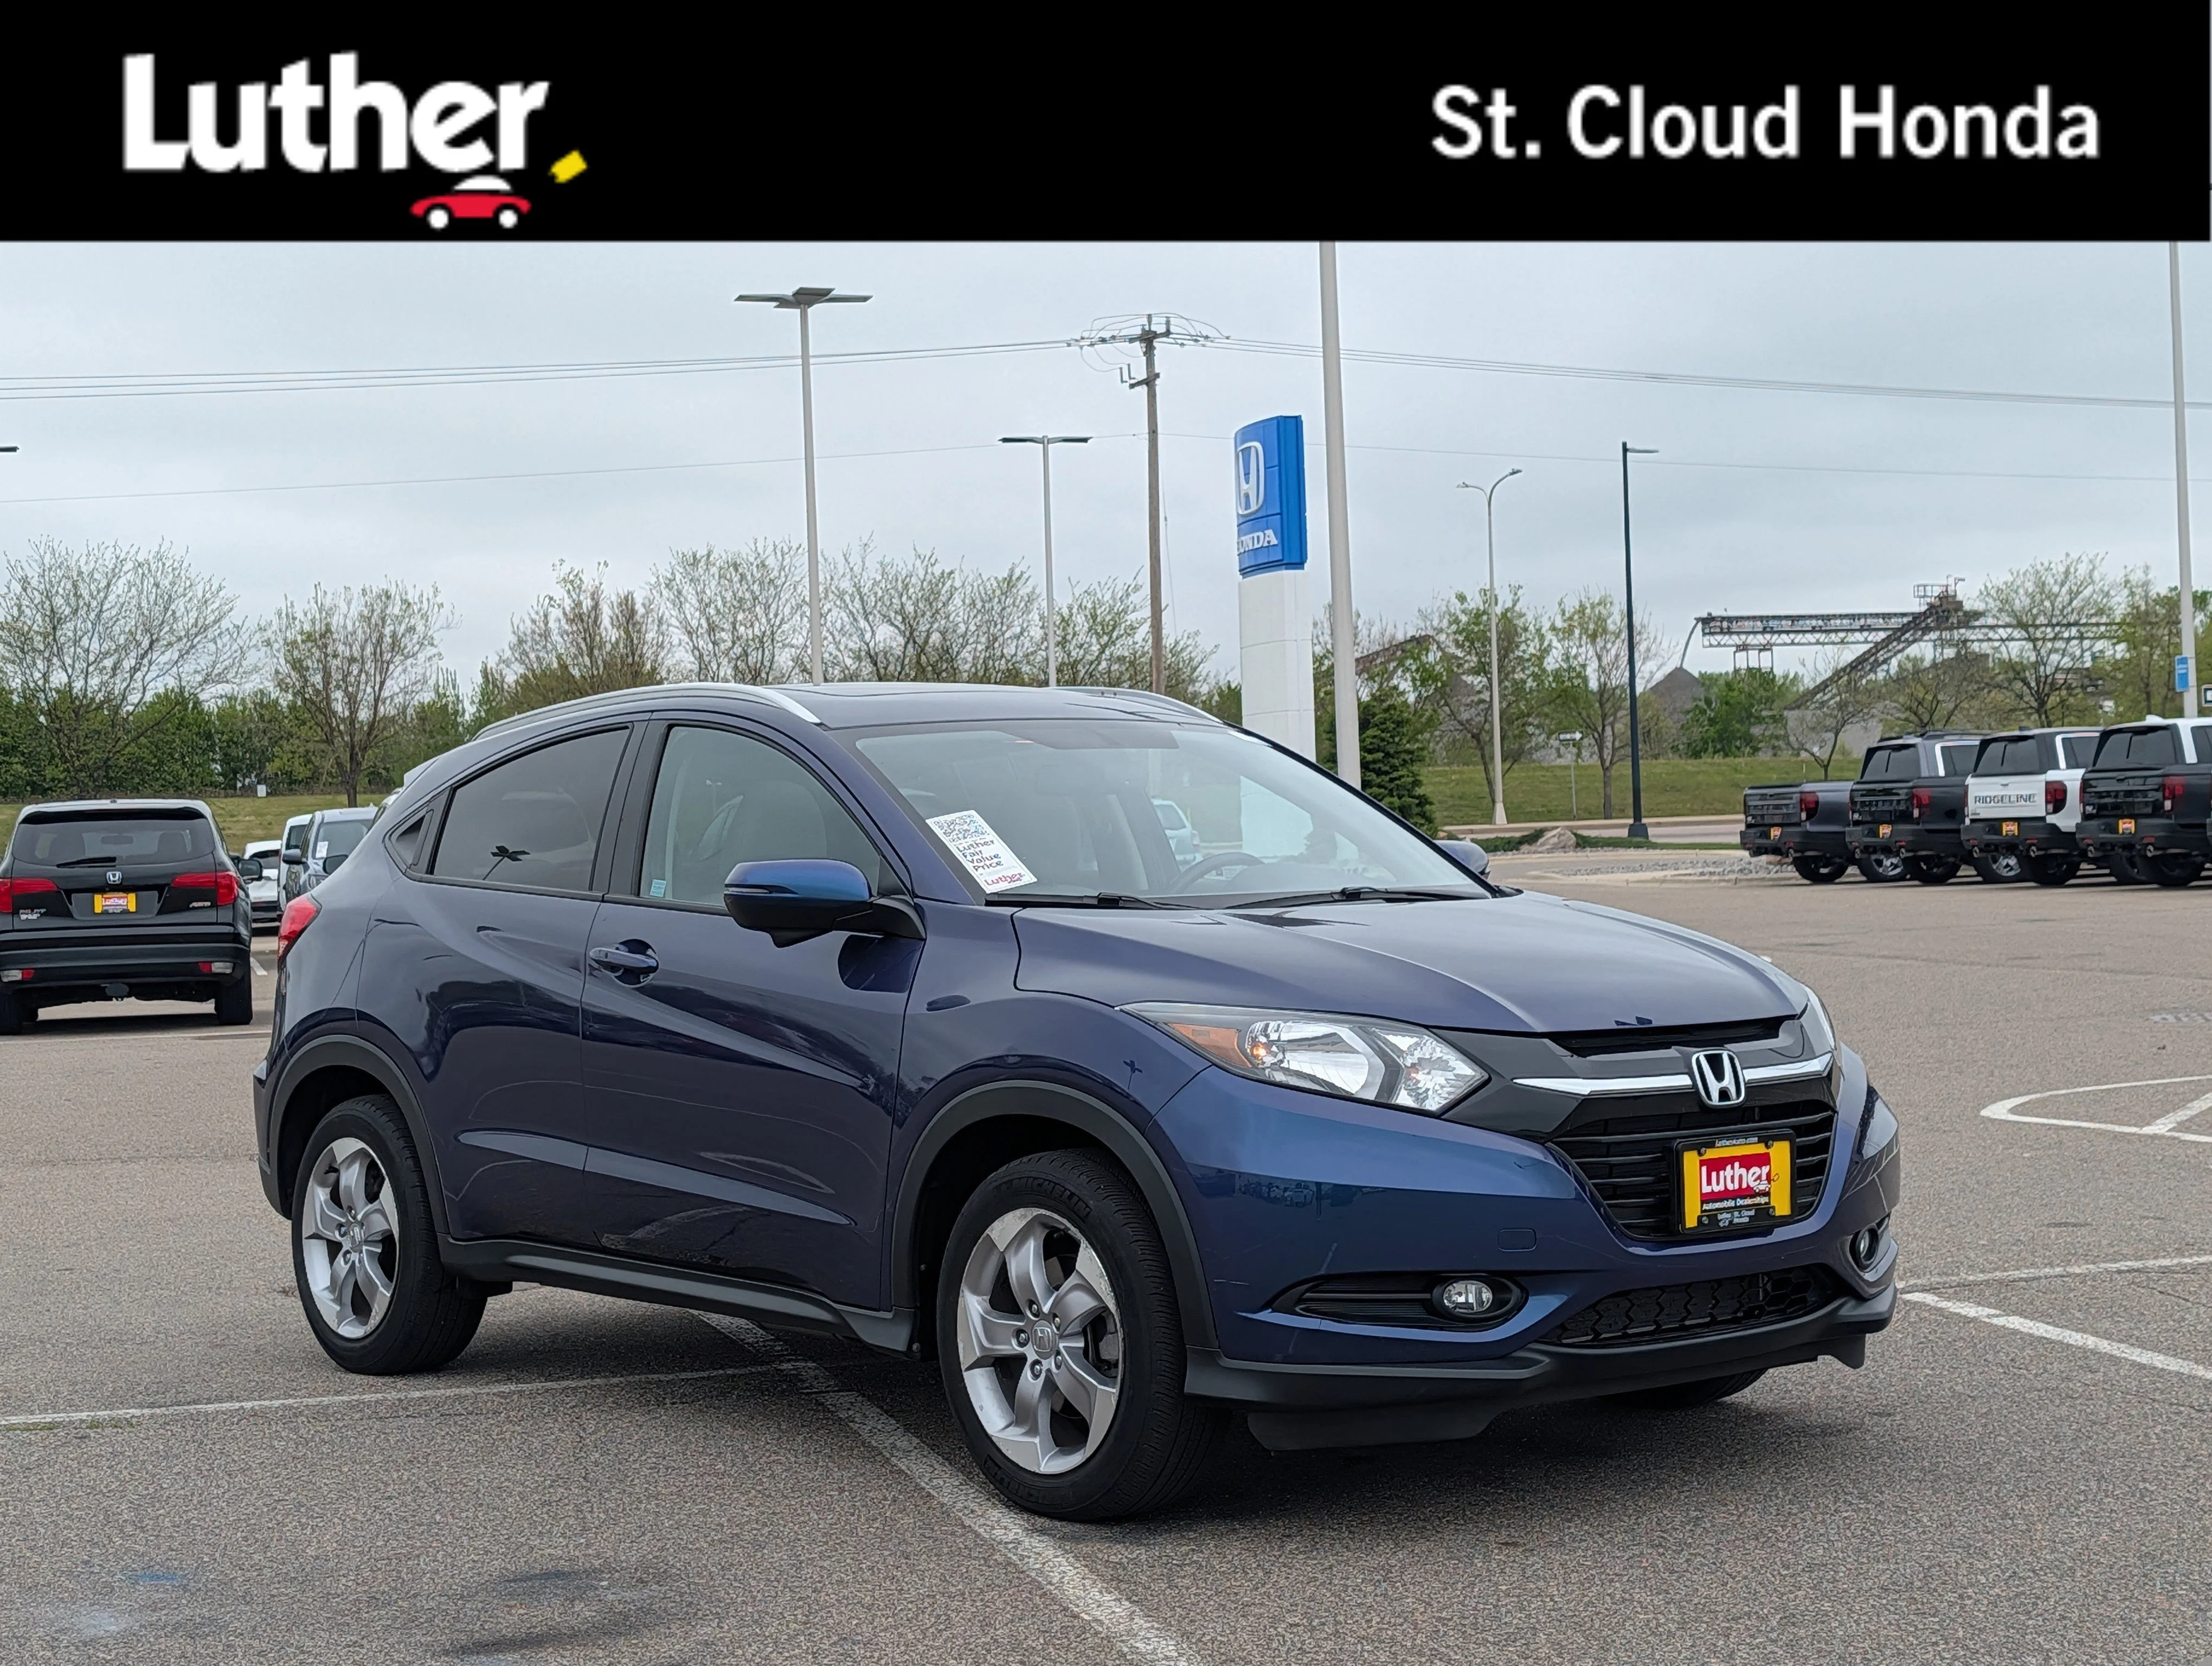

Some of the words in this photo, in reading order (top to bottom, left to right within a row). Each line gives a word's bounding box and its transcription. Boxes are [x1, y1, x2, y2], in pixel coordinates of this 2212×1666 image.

[1237, 529, 1278, 553] ONDA
[1974, 793, 2037, 804] RIDGELINE
[956, 840, 994, 853] Luther
[962, 850, 983, 858] Fair
[966, 854, 1001, 864] Value
[972, 861, 1004, 872] Price
[1701, 1161, 1770, 1193] Luther
